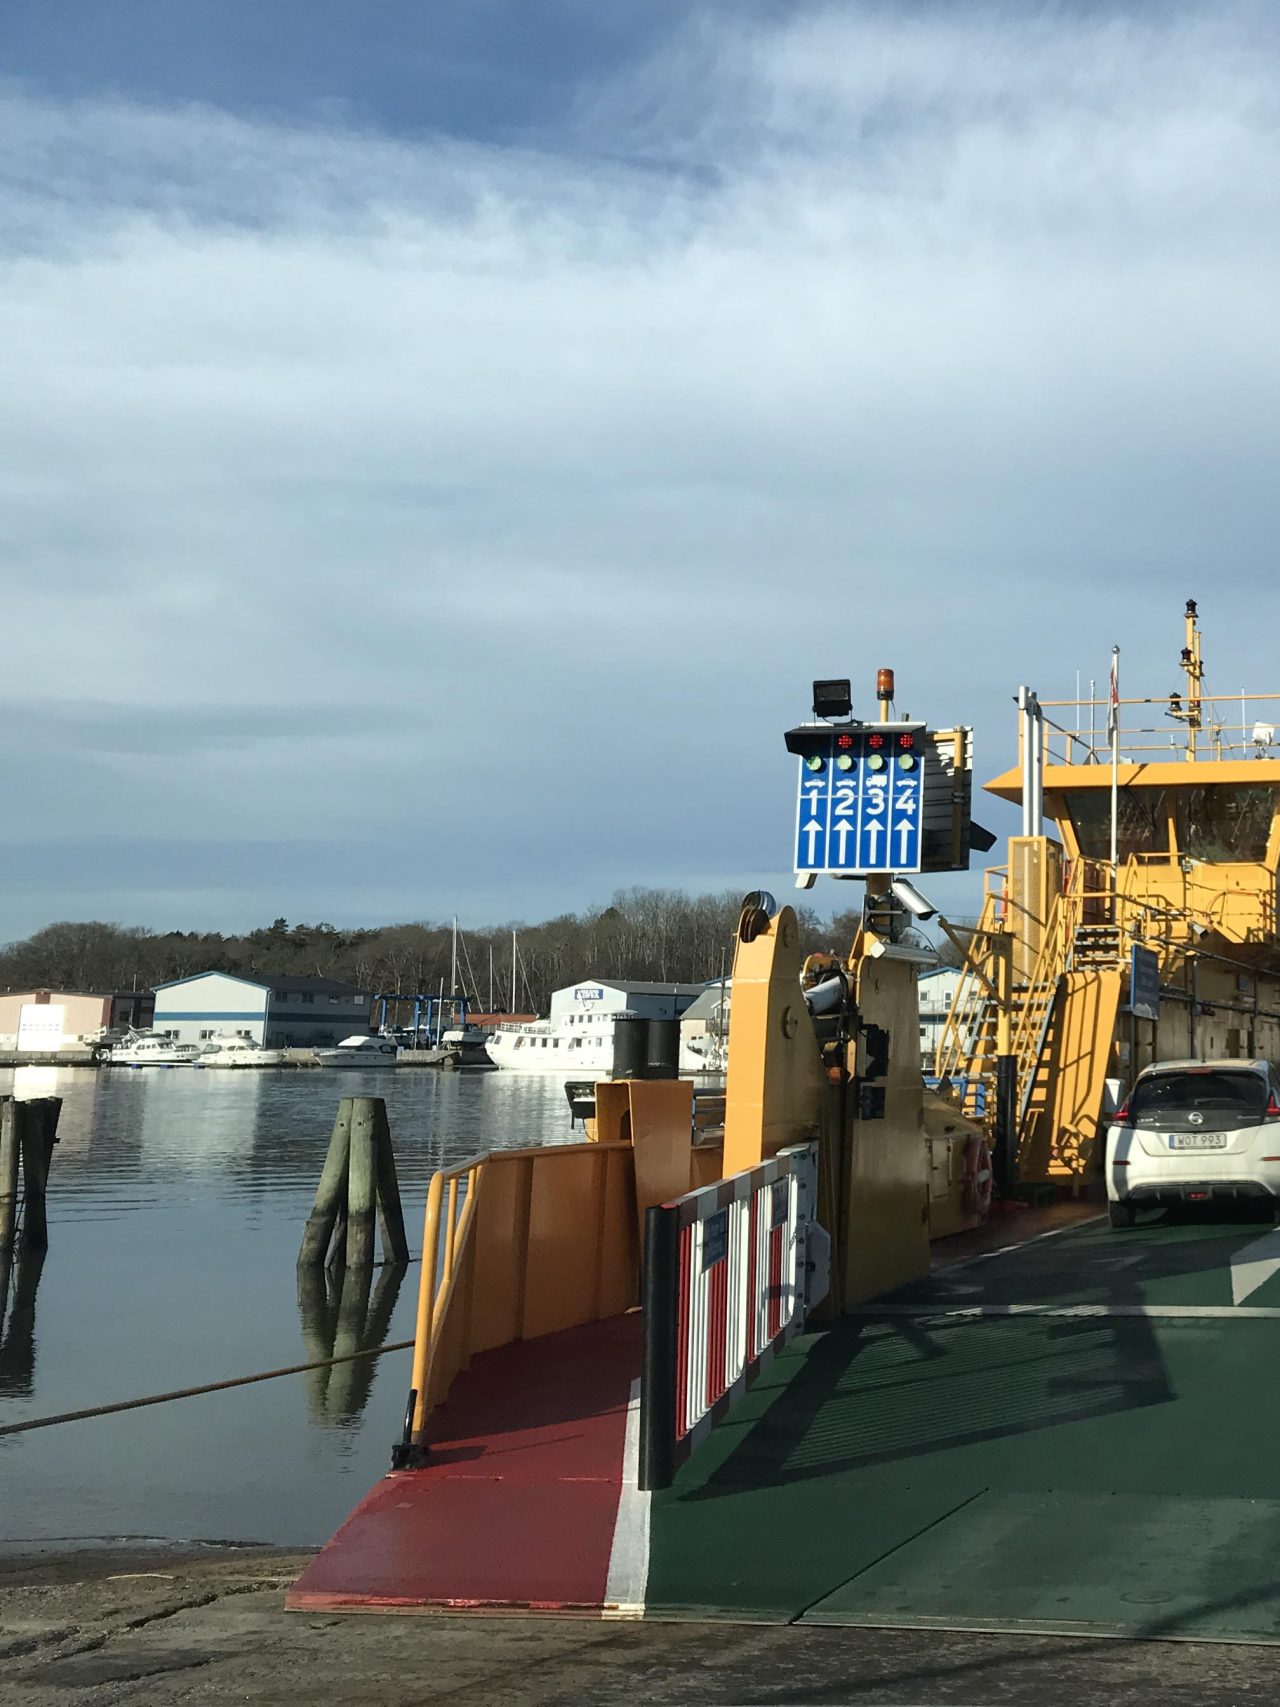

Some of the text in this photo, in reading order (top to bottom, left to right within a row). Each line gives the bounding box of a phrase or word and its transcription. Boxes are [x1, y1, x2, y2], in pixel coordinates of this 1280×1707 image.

[808, 788, 916, 816] 1 2 3 4
[1201, 1135, 1222, 1145] 993
